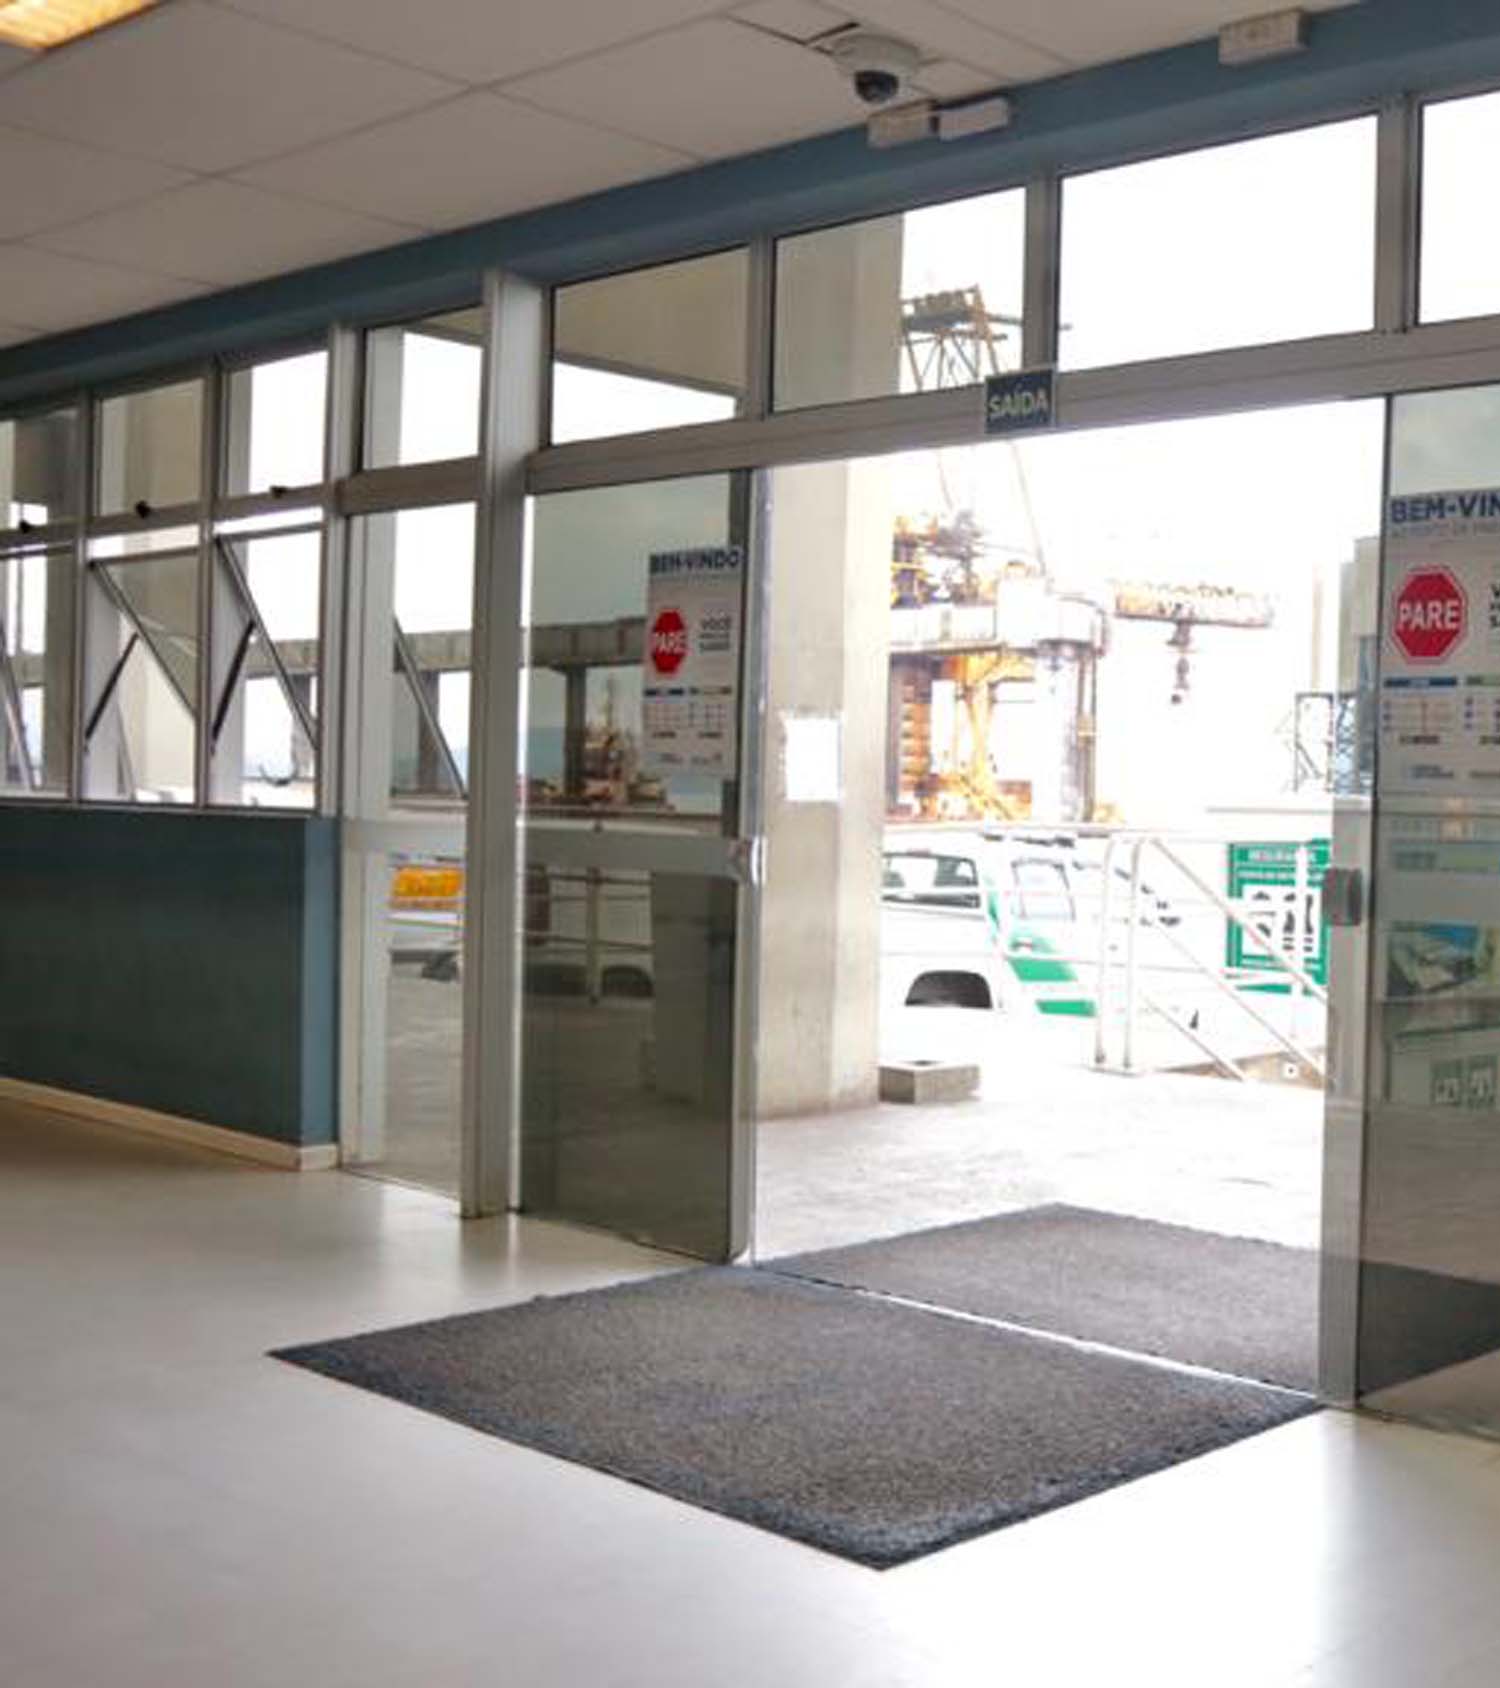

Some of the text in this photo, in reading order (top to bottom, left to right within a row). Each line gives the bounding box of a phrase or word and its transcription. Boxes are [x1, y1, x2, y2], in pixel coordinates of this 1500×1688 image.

[989, 386, 1049, 420] SAÍDA
[650, 550, 740, 574] BEM-VINDO
[1397, 600, 1460, 631] PARE
